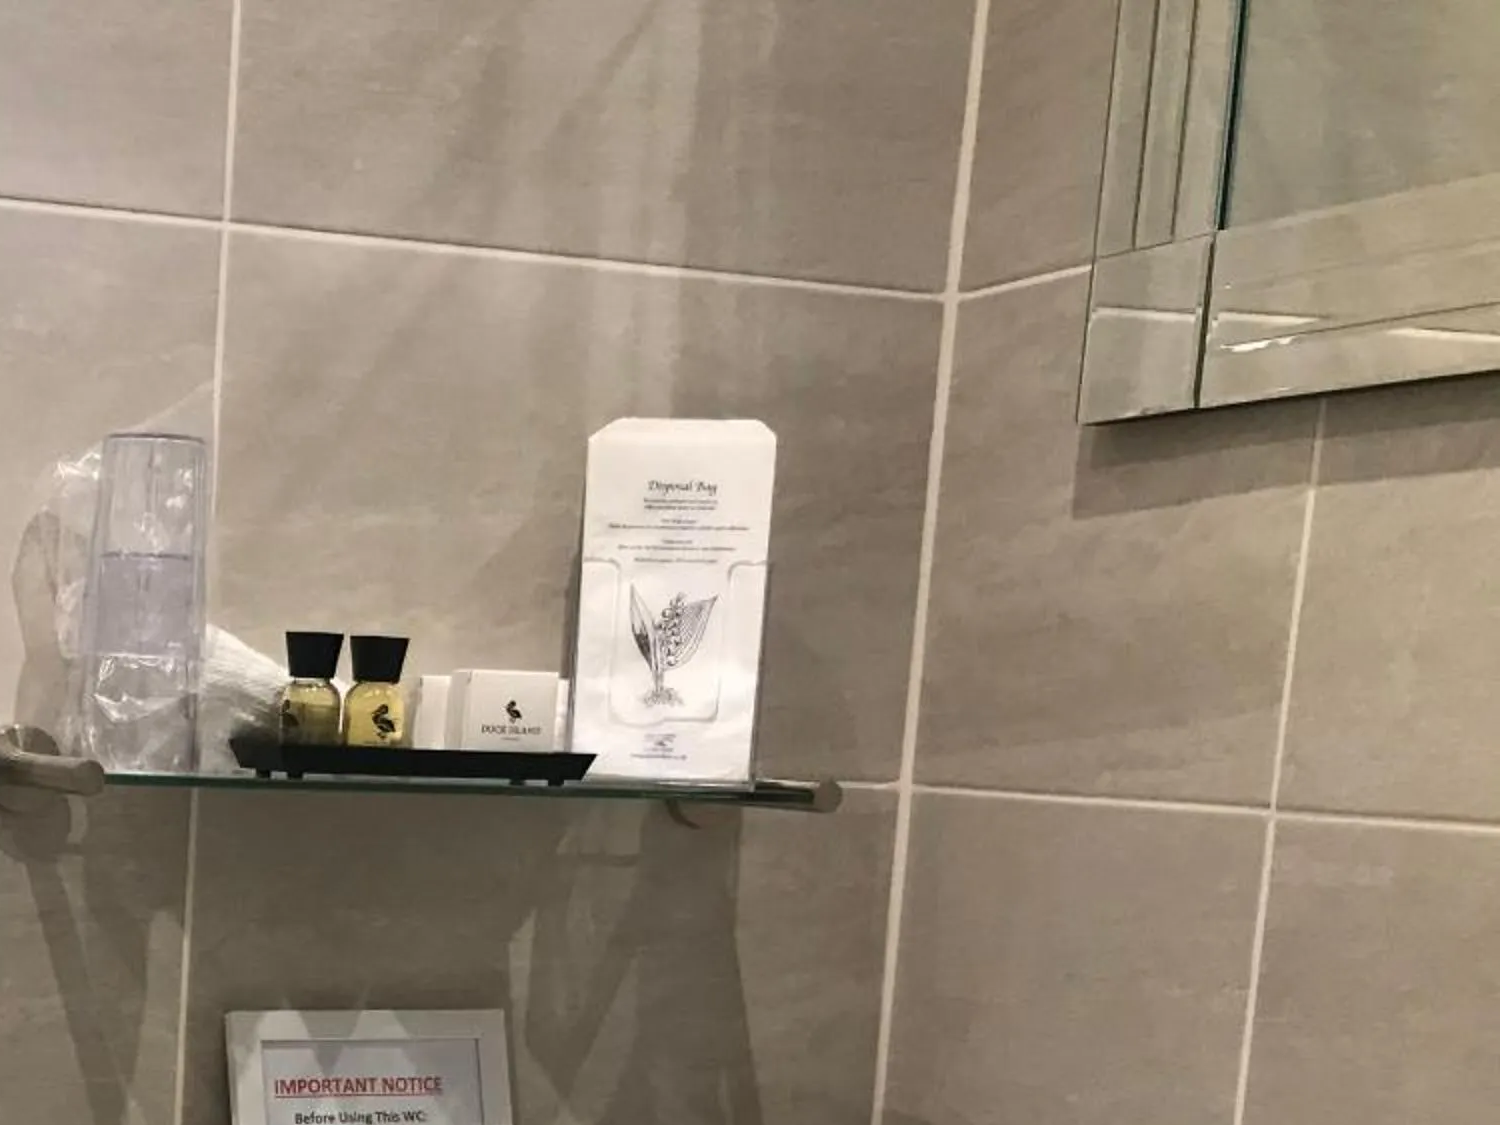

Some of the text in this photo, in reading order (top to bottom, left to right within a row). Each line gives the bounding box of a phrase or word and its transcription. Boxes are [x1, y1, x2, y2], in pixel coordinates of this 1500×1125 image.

[275, 1076, 443, 1097] IMPORTANT NOTICE
[295, 1112, 336, 1125] Before
[339, 1112, 373, 1125] Using
[376, 1111, 400, 1123] This
